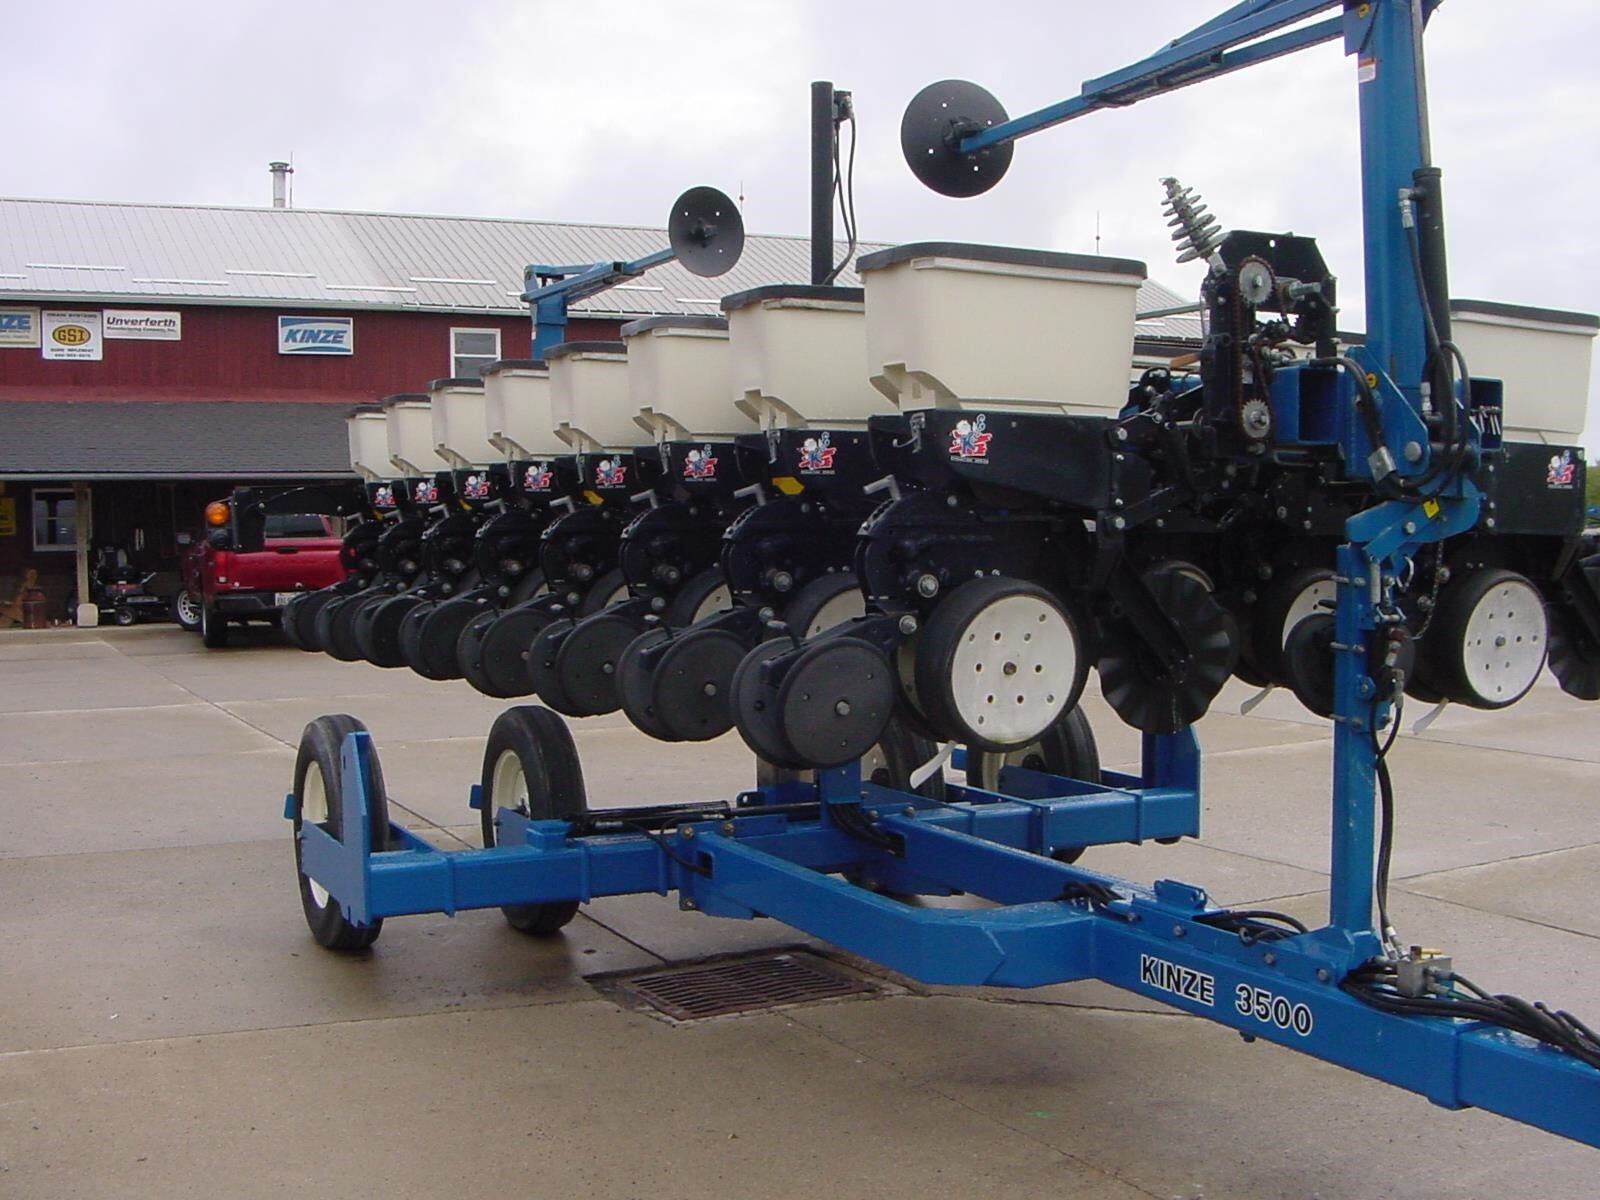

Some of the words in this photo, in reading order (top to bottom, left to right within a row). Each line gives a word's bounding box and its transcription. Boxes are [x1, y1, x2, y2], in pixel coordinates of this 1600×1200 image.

[0, 314, 31, 330] ZE
[106, 316, 176, 327] Unverferth
[57, 329, 86, 343] GSI
[284, 329, 347, 344] KINZE
[1141, 953, 1215, 1007] KINZE
[1235, 983, 1313, 1037] 3500
